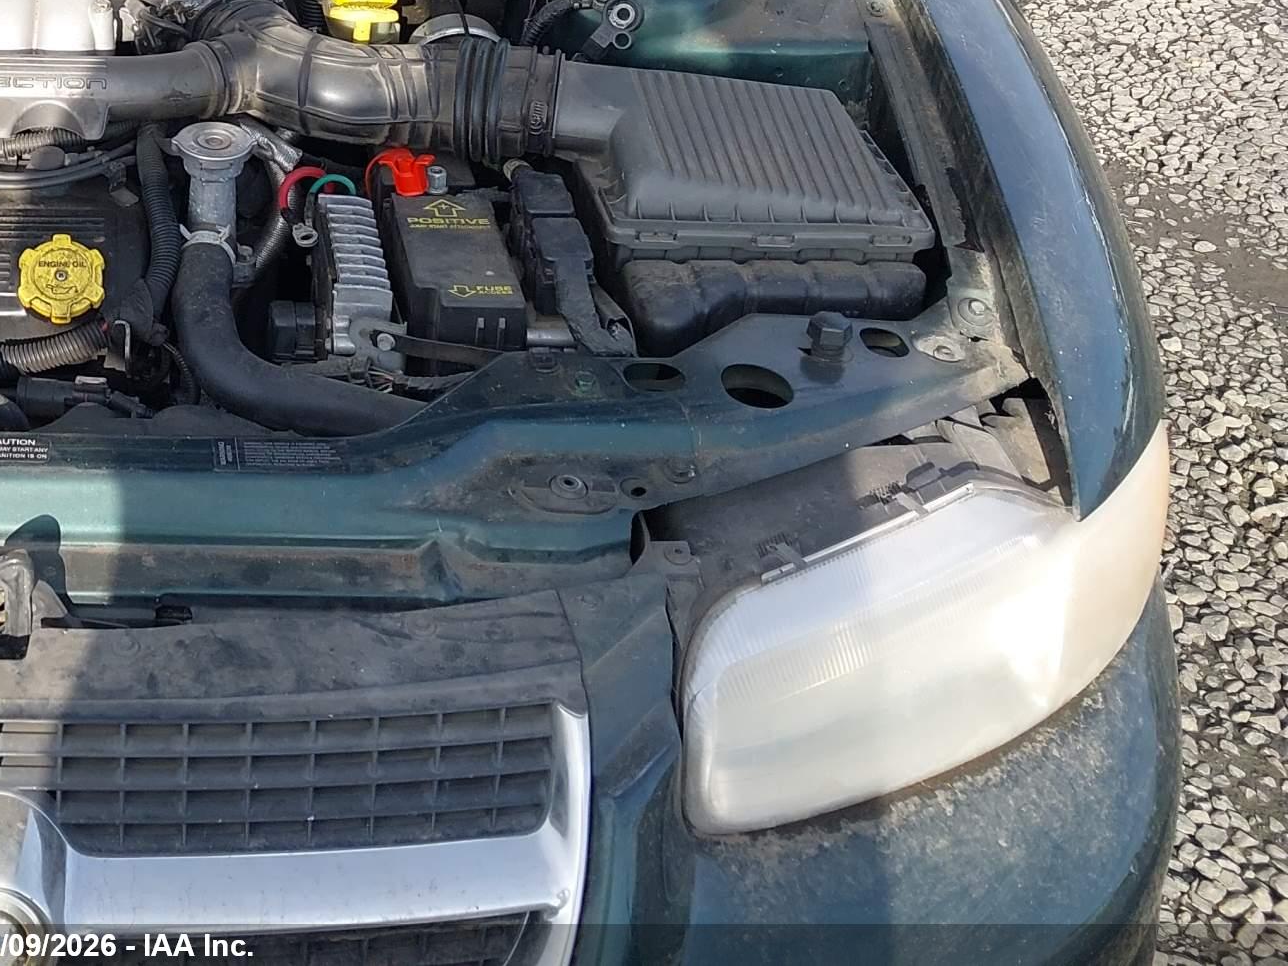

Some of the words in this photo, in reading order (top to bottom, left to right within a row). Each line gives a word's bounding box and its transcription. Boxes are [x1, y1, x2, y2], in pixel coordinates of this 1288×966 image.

[406, 217, 491, 225] POSITIVE
[38, 260, 70, 268] ENGINE
[72, 260, 87, 268] OIL
